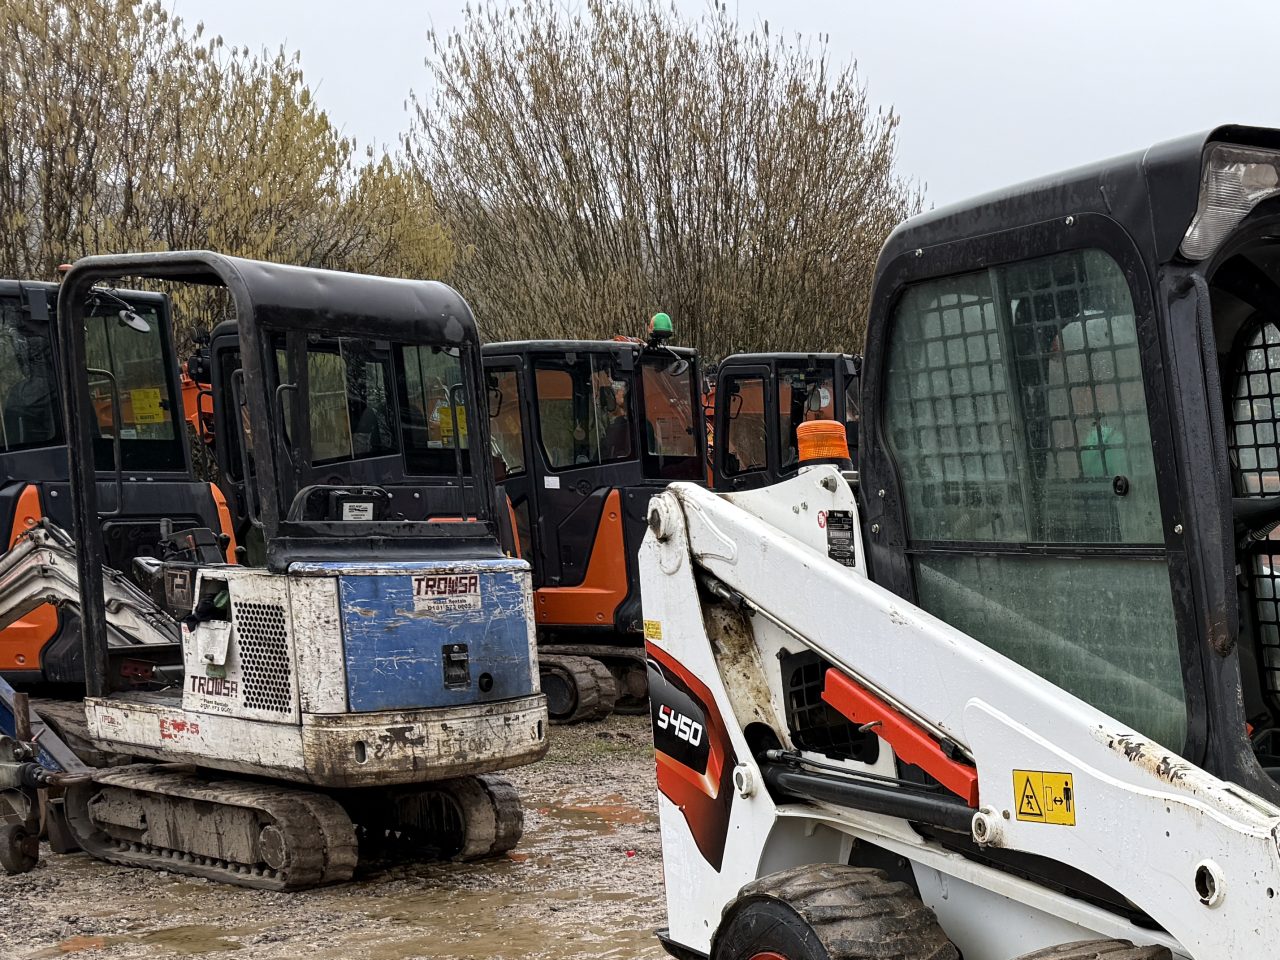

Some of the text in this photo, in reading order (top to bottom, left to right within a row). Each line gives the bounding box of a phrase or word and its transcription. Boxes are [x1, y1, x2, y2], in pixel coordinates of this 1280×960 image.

[414, 576, 478, 595] TROWSA
[190, 675, 238, 698] TROWSA
[657, 704, 703, 747] S450
